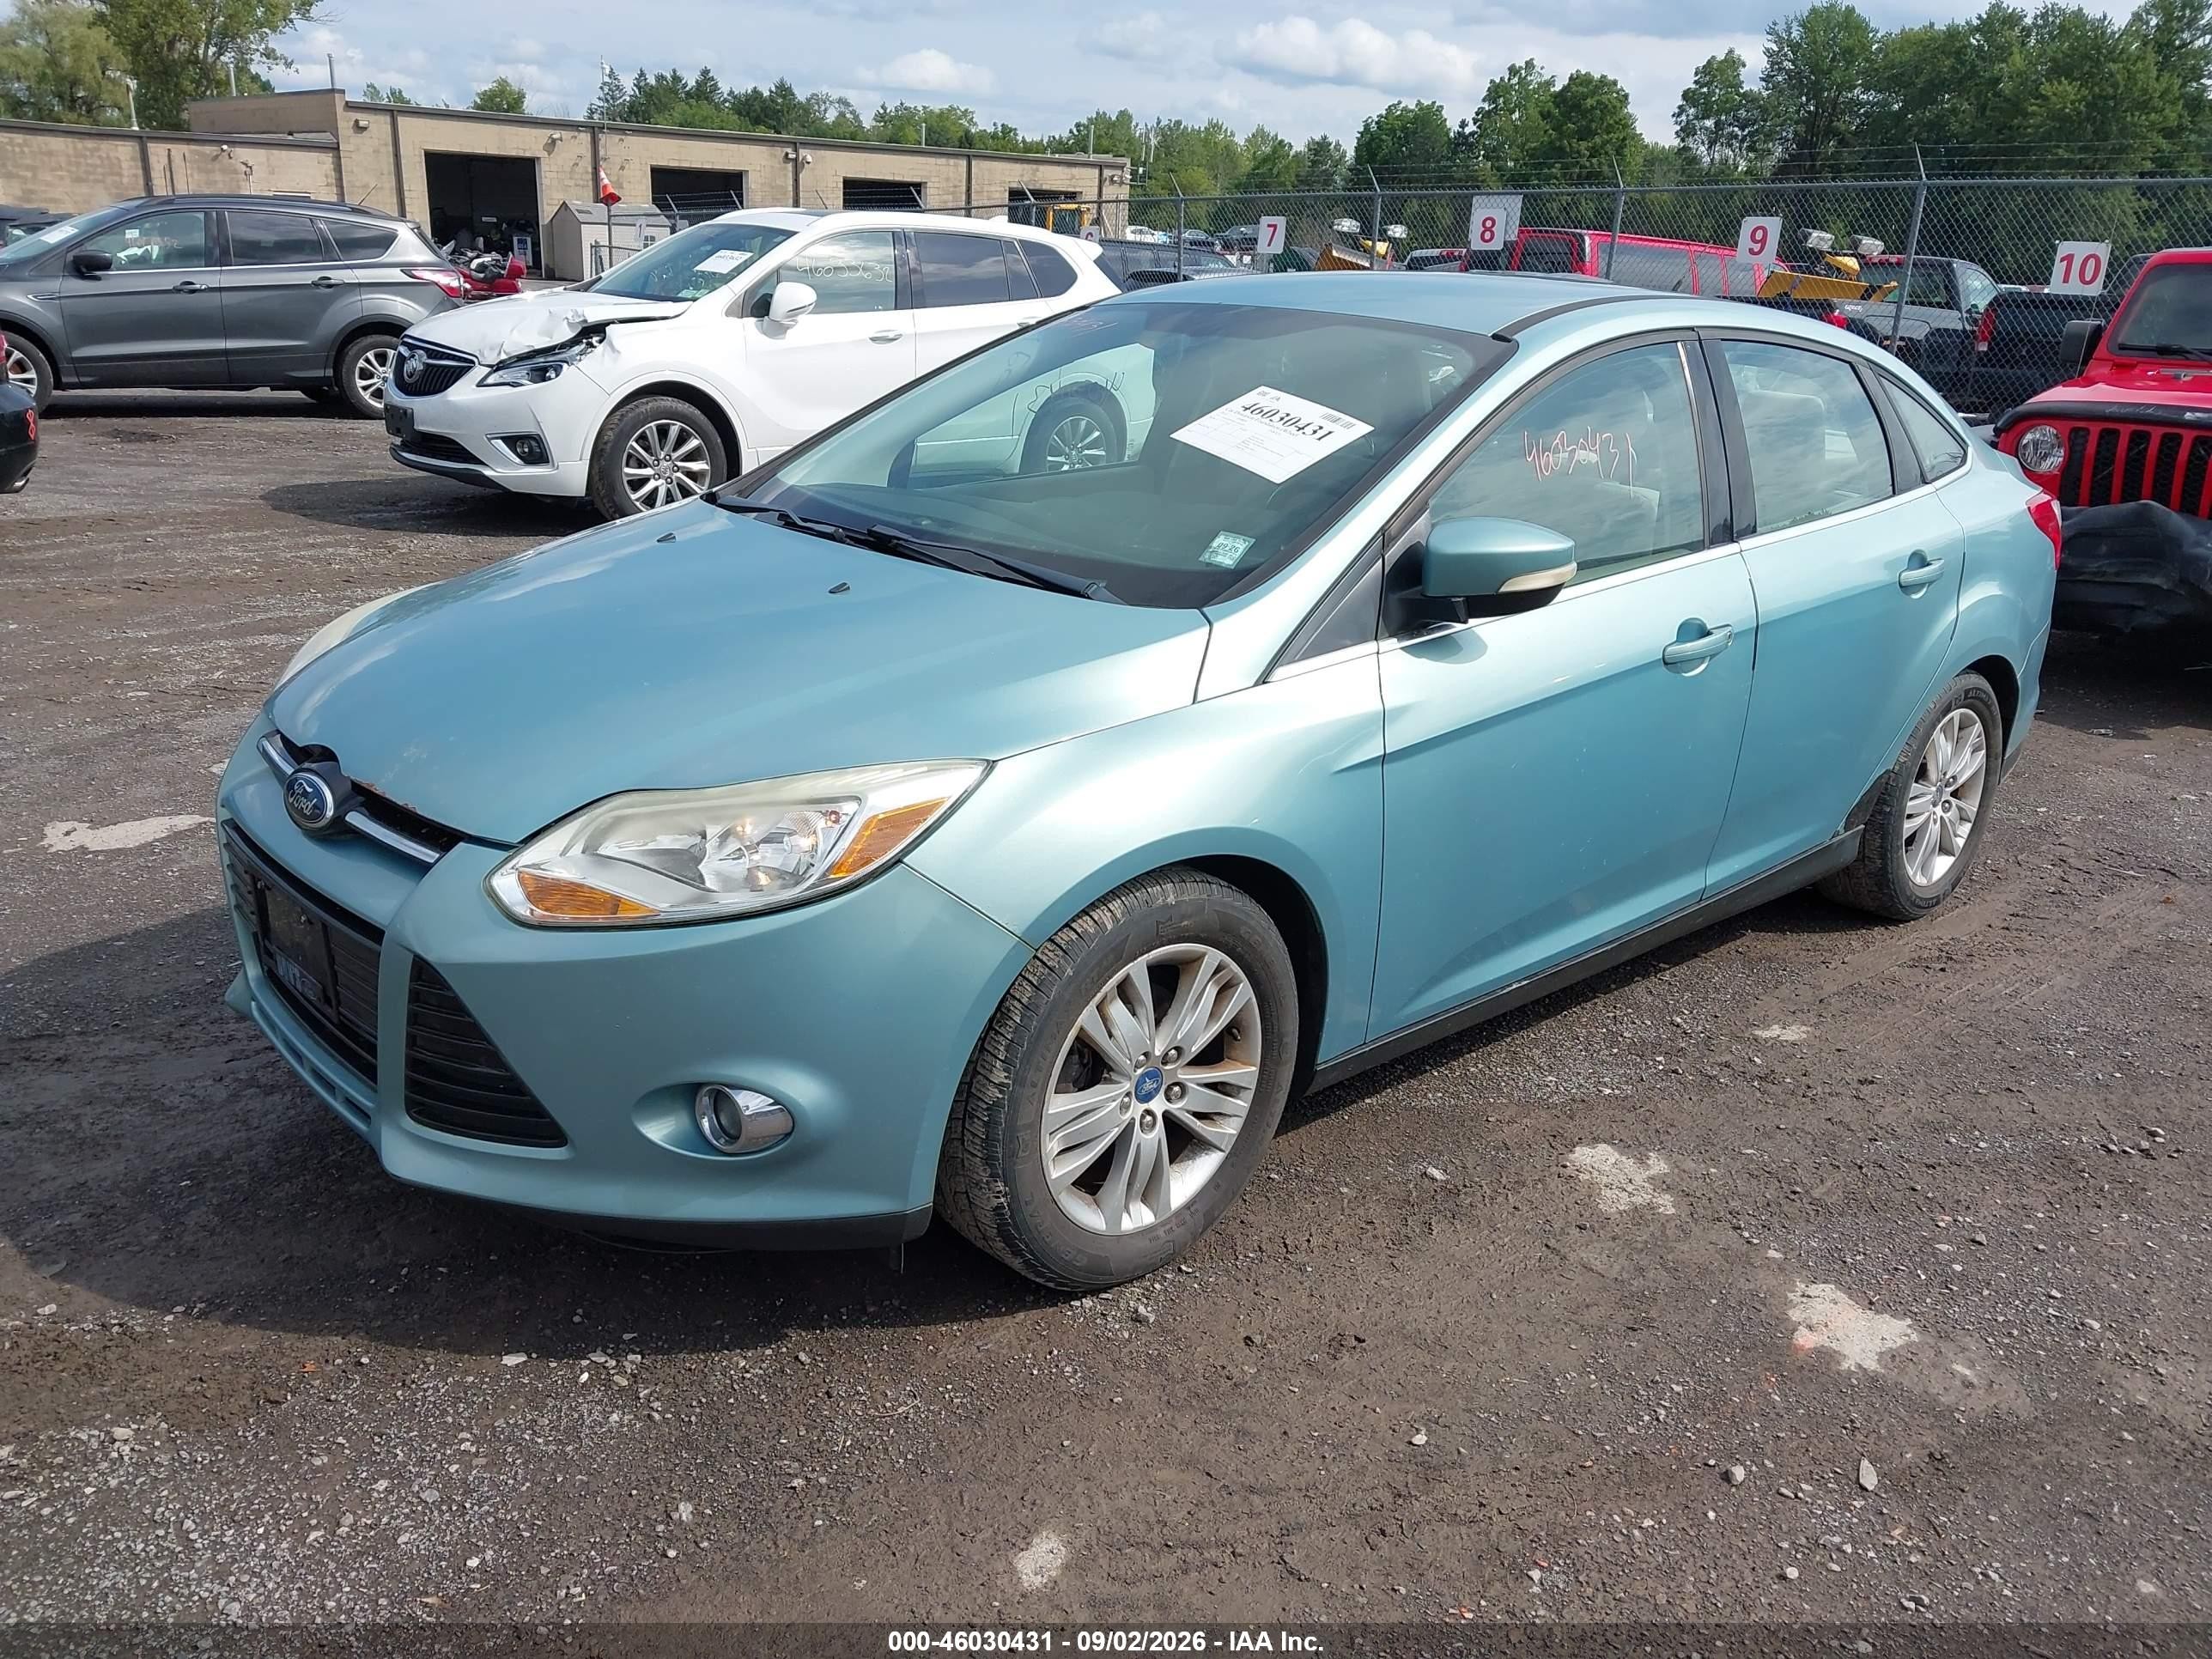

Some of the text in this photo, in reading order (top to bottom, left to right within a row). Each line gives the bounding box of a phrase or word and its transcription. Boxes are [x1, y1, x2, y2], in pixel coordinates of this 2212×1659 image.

[1266, 223, 1279, 247] 7
[1479, 216, 1497, 244] 8
[1747, 225, 1769, 257] 9
[2058, 253, 2102, 286] 10
[1241, 402, 1334, 441] 46030431
[1524, 426, 1638, 499] 46030431
[288, 779, 318, 816] Ford
